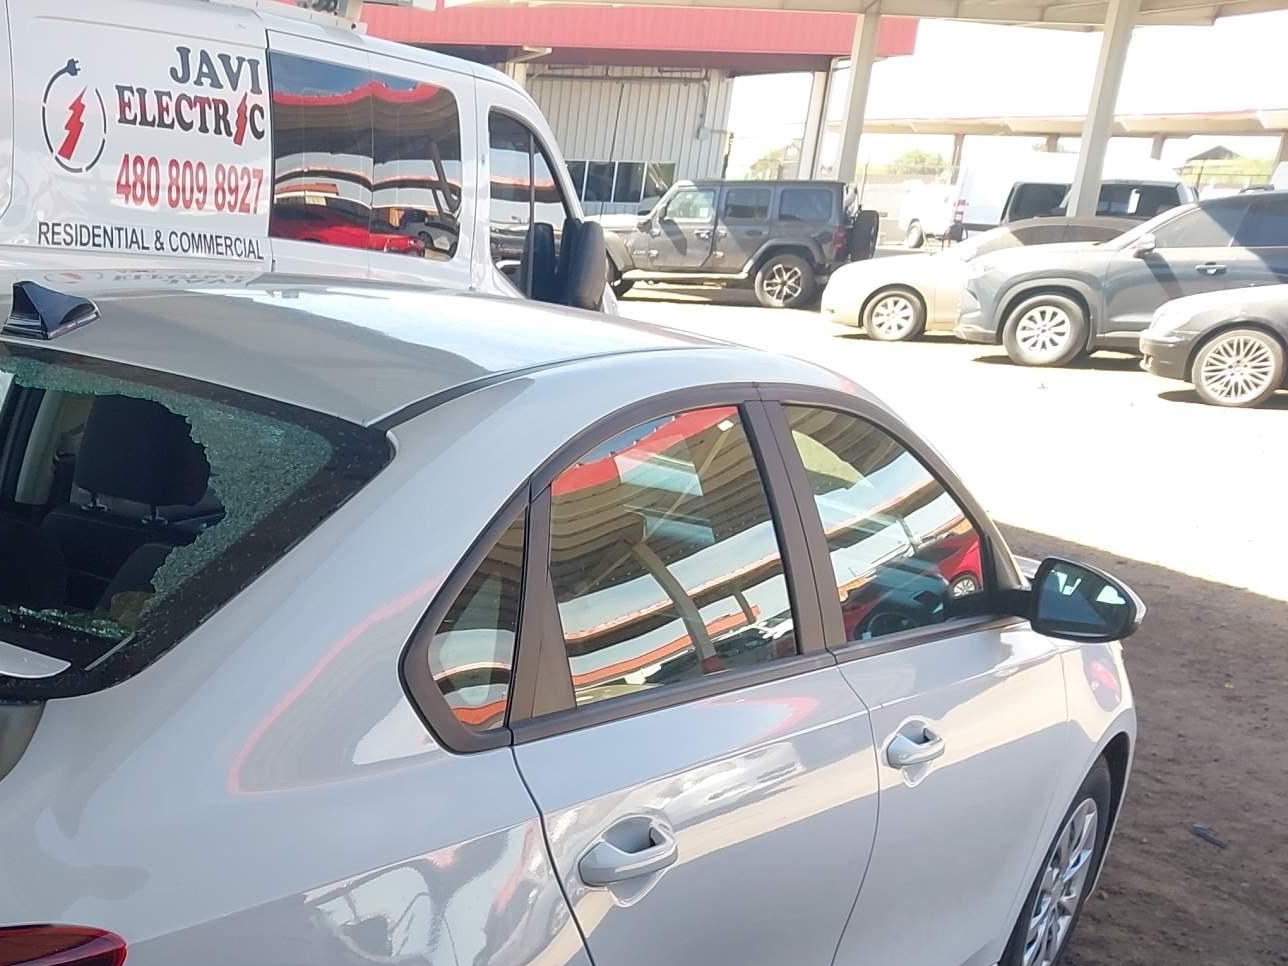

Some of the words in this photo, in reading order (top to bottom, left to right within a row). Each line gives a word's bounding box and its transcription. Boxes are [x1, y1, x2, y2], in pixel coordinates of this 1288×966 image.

[169, 46, 263, 95] JAVI
[116, 153, 161, 207] 480
[167, 158, 208, 210] 809
[214, 162, 264, 215] 8927
[38, 221, 150, 251] RESIDENTIAL
[154, 230, 165, 251] &
[169, 231, 264, 260] COMMERCIAL
